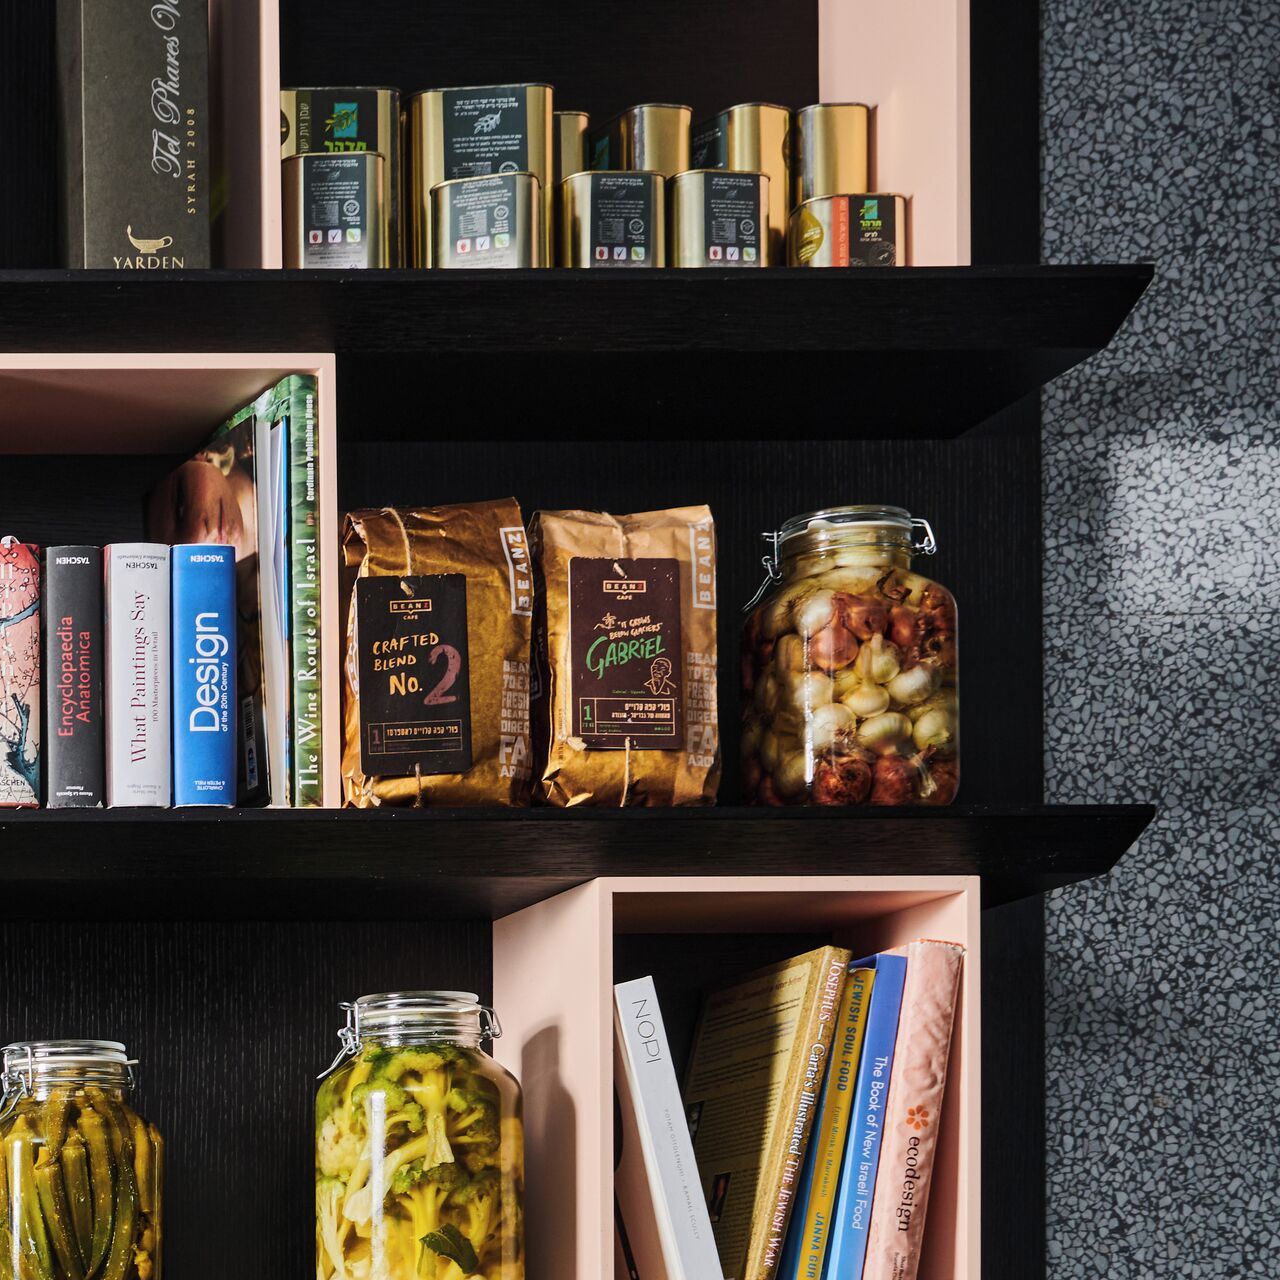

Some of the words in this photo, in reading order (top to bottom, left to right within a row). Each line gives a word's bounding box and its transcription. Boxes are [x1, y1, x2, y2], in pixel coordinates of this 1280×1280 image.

[186, 108, 196, 146] 2008
[152, 129, 182, 178] Tel
[187, 159, 196, 214] SYRAH
[113, 256, 184, 270] YARDEN
[306, 420, 314, 461] Publishing
[56, 556, 90, 564] TASCHEN
[126, 562, 158, 570] TASCHEN
[190, 555, 225, 563] TASCHEN
[296, 538, 316, 588] Israel
[508, 532, 530, 608] BEANZ
[130, 590, 150, 620] Say
[297, 600, 316, 618] of
[392, 602, 430, 610] BEANZ
[298, 628, 316, 681] Route
[372, 632, 440, 656] CRAFTED
[57, 616, 78, 737] Encyclopaedia
[76, 631, 90, 723] Anatomica
[130, 627, 150, 707] Paintings
[188, 612, 229, 732] Design
[220, 662, 229, 690] Century
[374, 654, 417, 672] BLEND
[424, 644, 462, 706] 2
[152, 661, 160, 711] Masterpieces
[220, 693, 228, 709] 20th
[220, 710, 228, 722] the
[220, 722, 228, 732] of
[298, 692, 317, 745] Wine
[130, 716, 147, 764] What
[298, 754, 318, 789] The
[818, 959, 846, 1021] JOSEPHUS
[846, 976, 864, 1022] JEWISH
[632, 999, 662, 1063] NOPI
[841, 1026, 858, 1058] SOUL
[804, 1042, 826, 1088] Carta's
[837, 1060, 851, 1092] FOOD
[873, 1056, 888, 1077] The
[869, 1082, 884, 1111] Book
[788, 1089, 816, 1155] Illustrated
[867, 1114, 878, 1128] of
[862, 1130, 878, 1158] New
[782, 1160, 800, 1185] THE
[858, 1162, 872, 1196] Israeli
[895, 1136, 920, 1232] ecodesign
[771, 1186, 792, 1232] JEWISH
[852, 1199, 867, 1230] Food
[812, 1212, 825, 1250] JANNA
[764, 1237, 780, 1267] WAR
[807, 1254, 818, 1279] GUR
